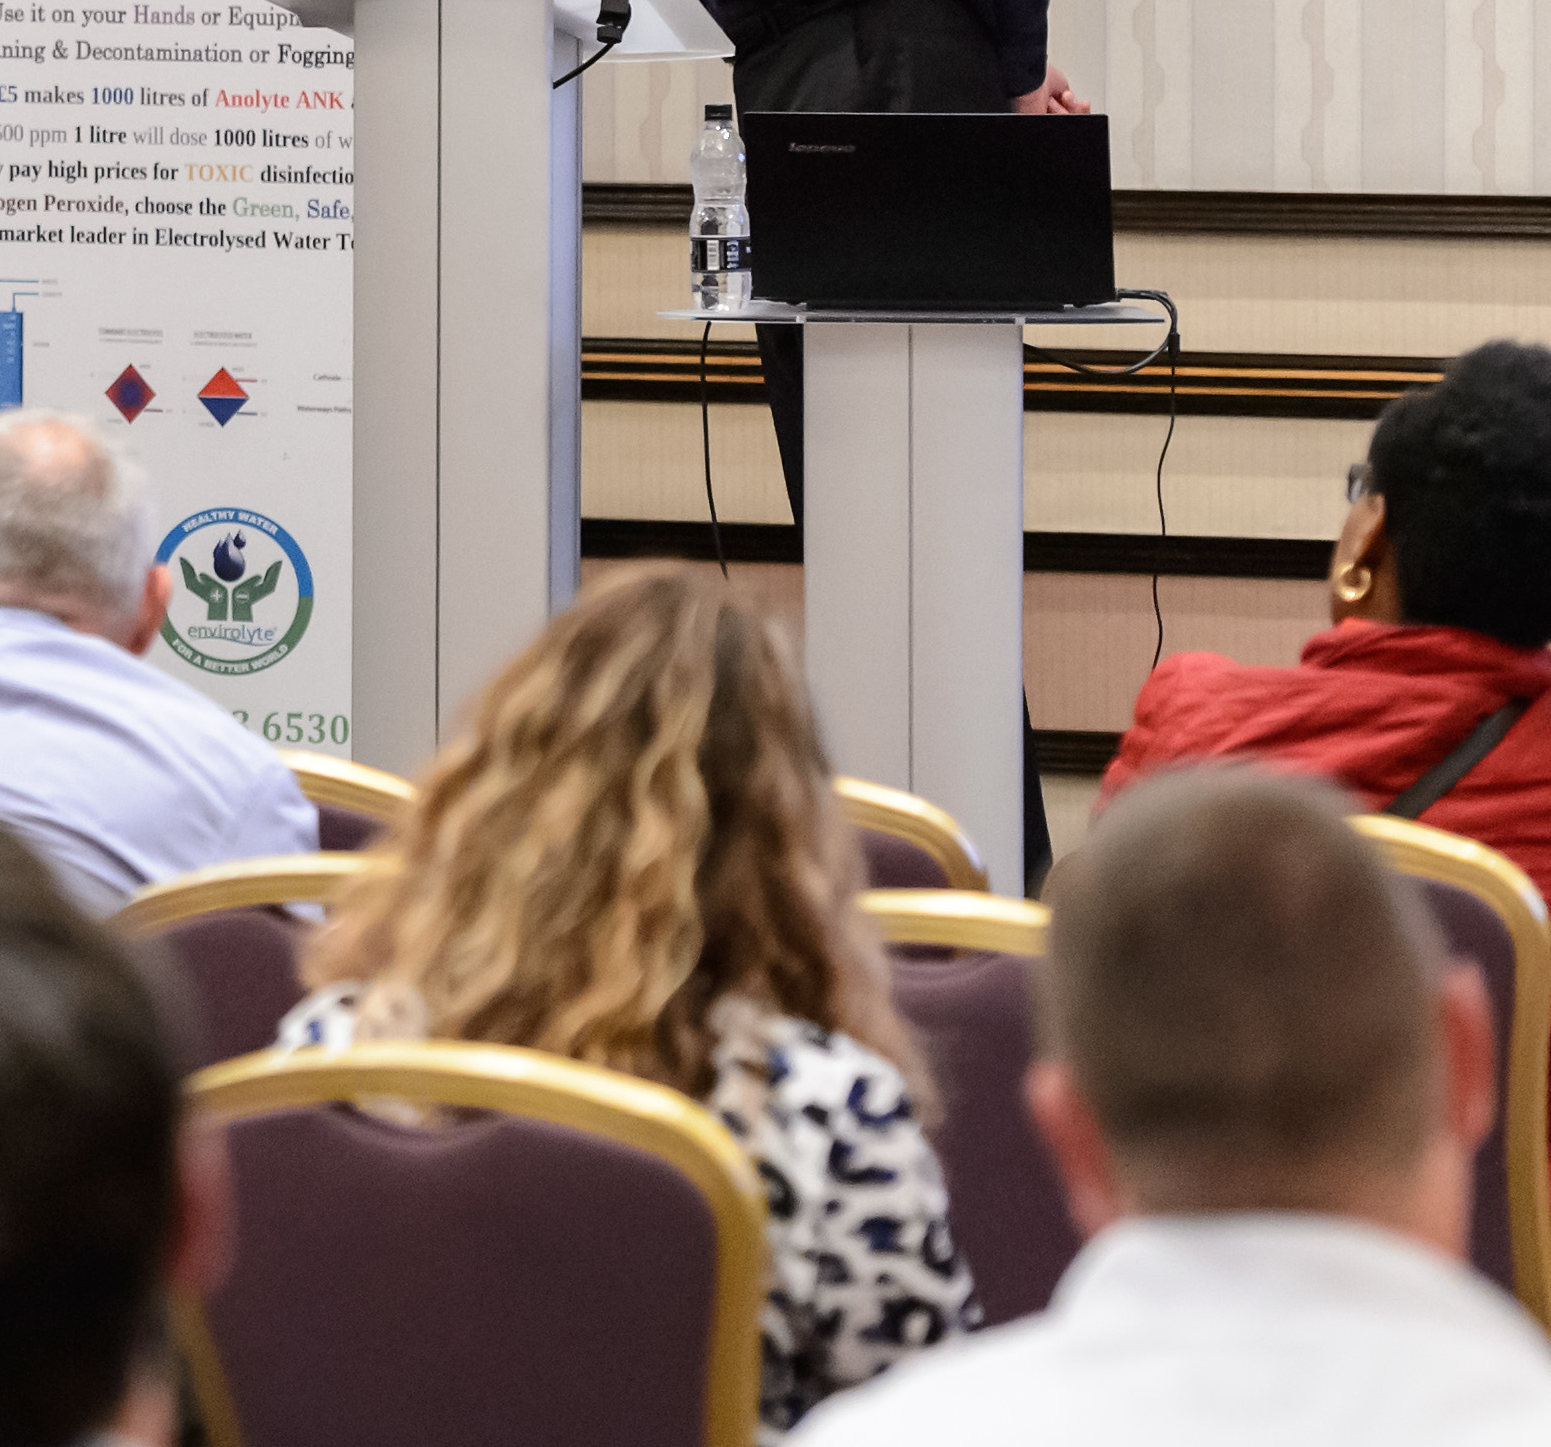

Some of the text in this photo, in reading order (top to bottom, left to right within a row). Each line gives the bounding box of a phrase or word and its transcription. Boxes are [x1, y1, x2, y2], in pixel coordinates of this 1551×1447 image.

[31, 3, 45, 22] it
[52, 10, 75, 23] on
[82, 10, 126, 27] your
[134, 5, 195, 25] Hands
[201, 12, 221, 25] or
[52, 40, 68, 59] &
[76, 41, 242, 62] Decontamination
[249, 50, 270, 63] or
[278, 44, 354, 68] Fogging
[25, 86, 84, 104] makes
[93, 88, 133, 104] 1000
[141, 87, 185, 106] litres
[192, 88, 208, 107] of
[216, 89, 289, 113] Anolyte
[297, 91, 344, 109] ANK
[30, 129, 67, 147] ppm
[76, 126, 81, 142] 1
[90, 126, 126, 143] litre
[133, 126, 163, 145] will
[170, 127, 207, 146] dose
[215, 129, 255, 146] 1000
[263, 129, 308, 147] litres
[315, 130, 332, 148] of
[10, 165, 41, 182] pay
[49, 160, 87, 183] high
[95, 161, 147, 183] prices
[154, 163, 178, 180] for
[185, 164, 251, 182] TOXIC
[261, 165, 353, 184] disinfectio
[45, 195, 128, 216] Peroxide,
[135, 196, 192, 215] choose
[199, 198, 226, 215] the
[233, 197, 300, 222] Green,
[0, 225, 62, 242] market
[71, 226, 126, 244] leader
[133, 227, 148, 245] in
[156, 228, 265, 252] Electrolysed
[274, 232, 331, 250] Water
[182, 511, 278, 535] HEALTHY WATER
[187, 624, 275, 646] envirolyte
[172, 638, 288, 673] FOR A BETTER WORLD
[263, 711, 349, 745] 6530
